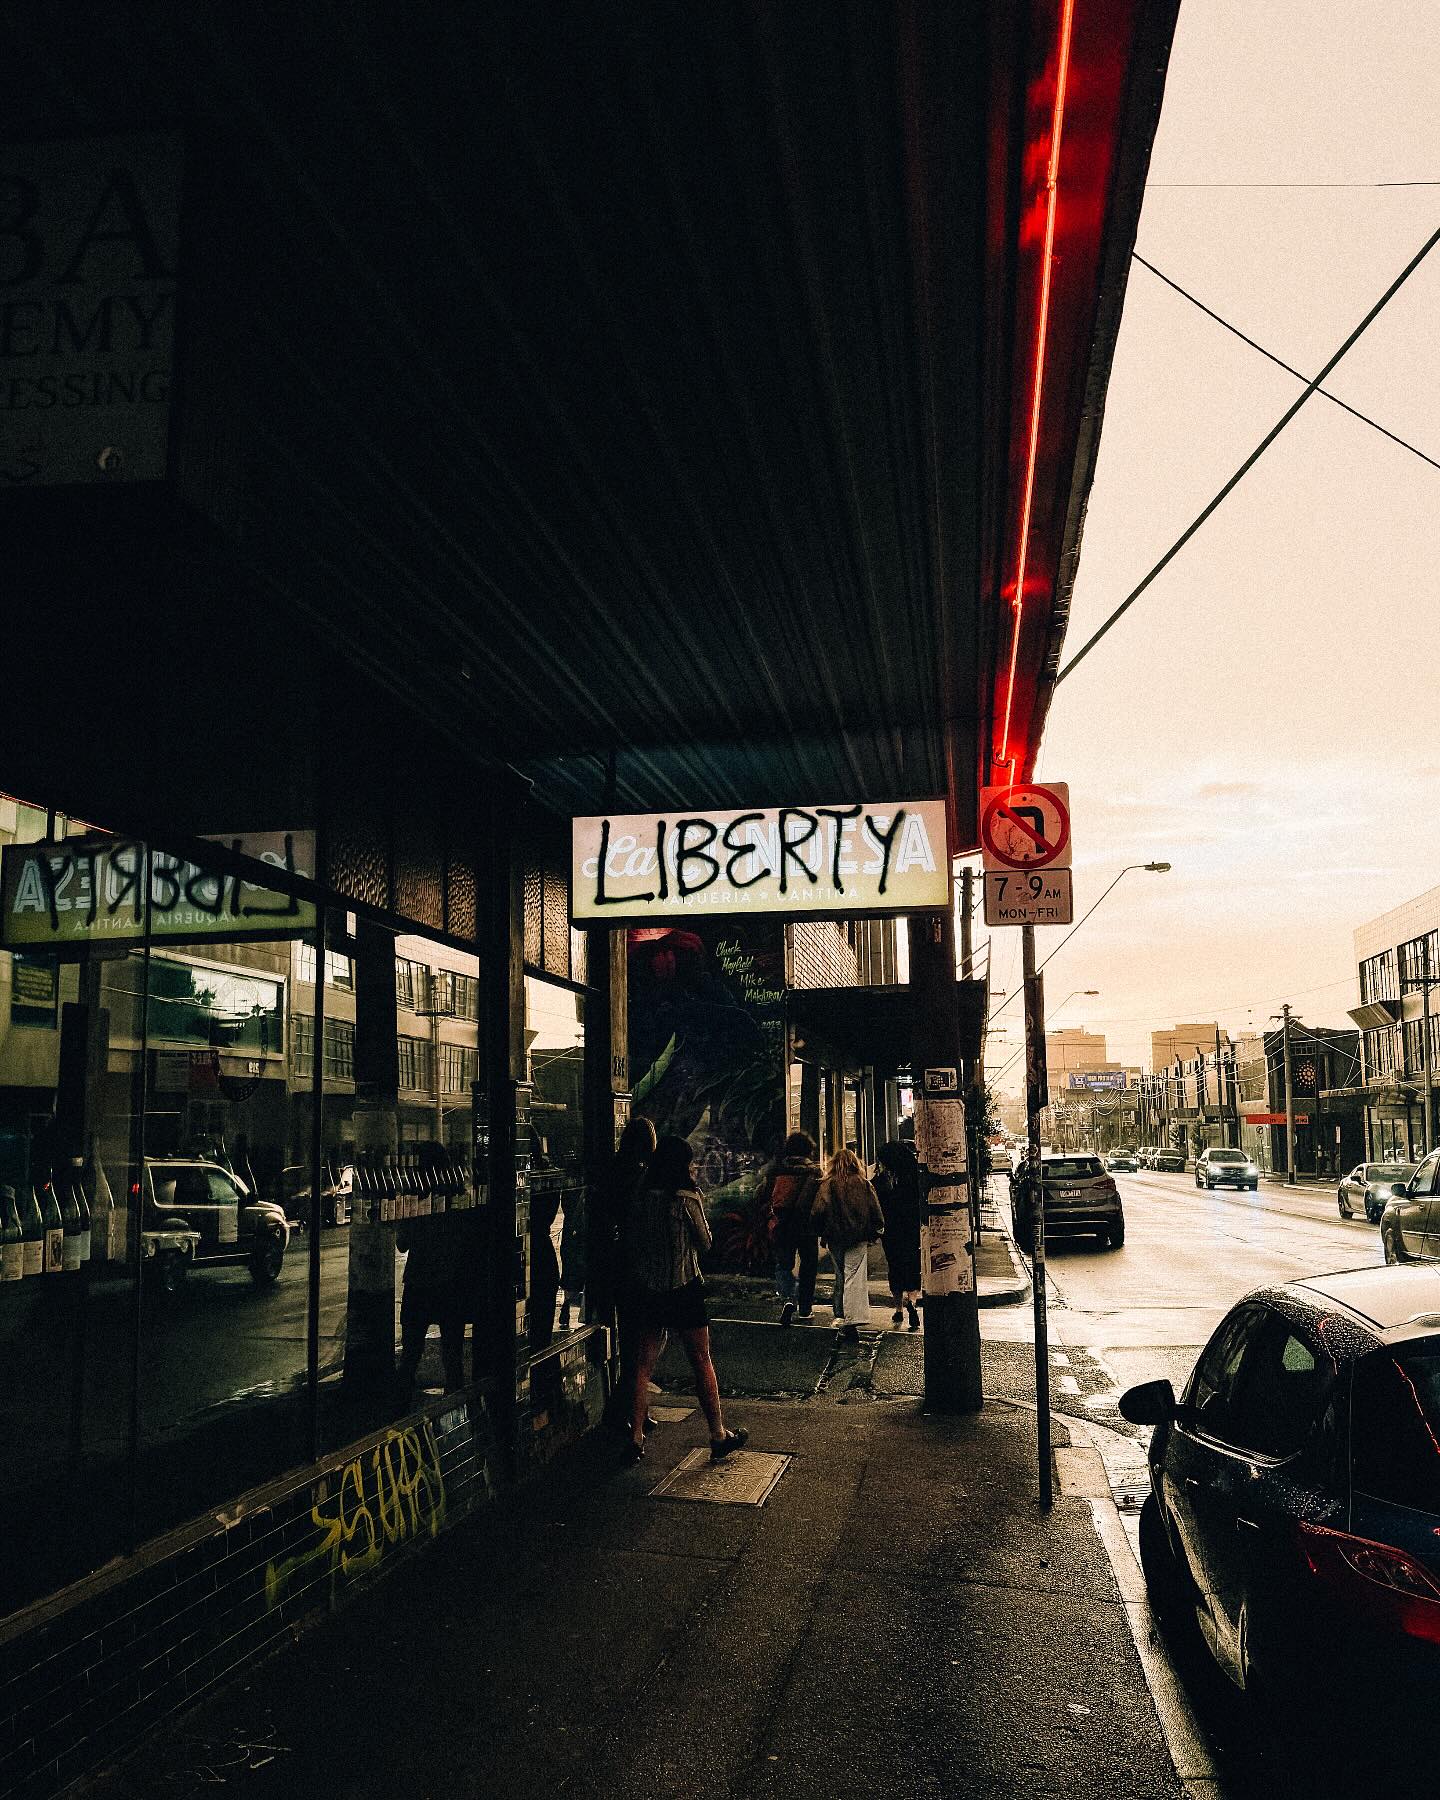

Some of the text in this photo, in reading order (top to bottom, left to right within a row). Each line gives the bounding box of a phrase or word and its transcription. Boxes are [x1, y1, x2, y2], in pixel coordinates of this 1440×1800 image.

[0, 369, 170, 412] ESSING
[594, 804, 906, 906] LIBERTY
[661, 888, 751, 906] AQUERIA
[998, 907, 1058, 920] MON-FRI
